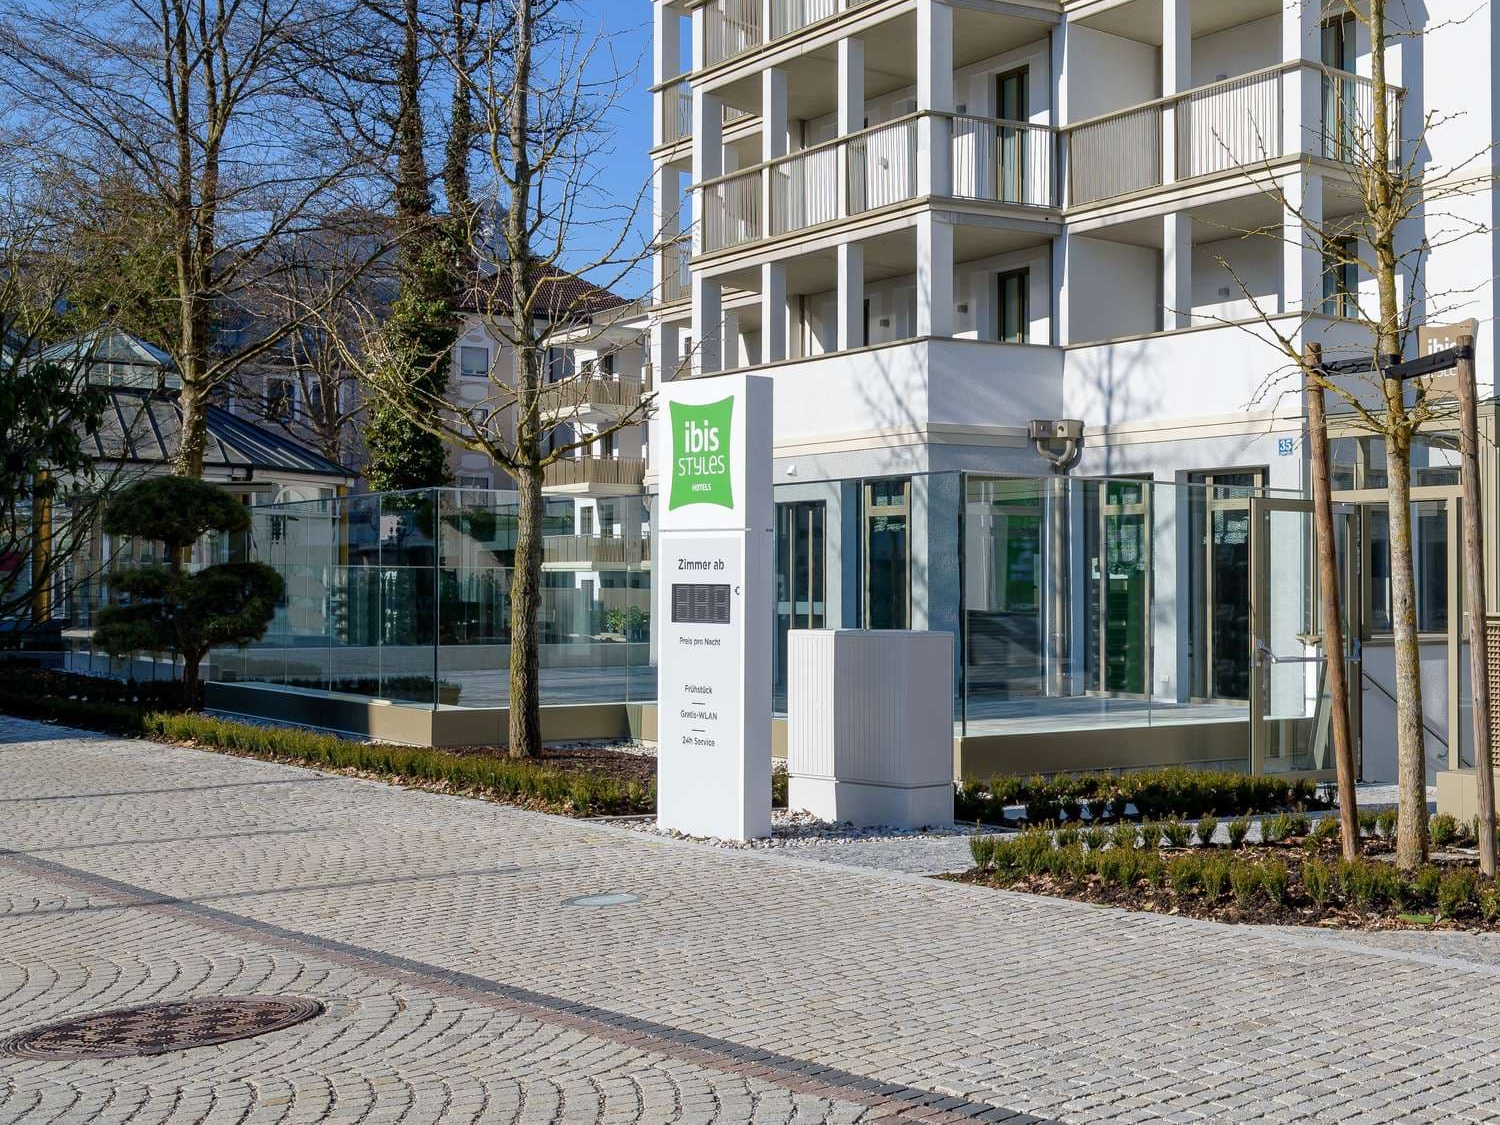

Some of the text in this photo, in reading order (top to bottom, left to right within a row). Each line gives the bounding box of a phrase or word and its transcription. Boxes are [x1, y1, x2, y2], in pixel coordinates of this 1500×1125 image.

[685, 420, 719, 453] ibis
[1280, 439, 1292, 452] 35
[692, 483, 711, 491] HOTELS
[678, 559, 725, 570] Zimmer ab
[680, 637, 720, 646] Preis pro Nacht
[684, 684, 712, 694] Frühstück
[680, 709, 717, 720] Gratis-WLAN
[682, 736, 715, 747] 24h Service
